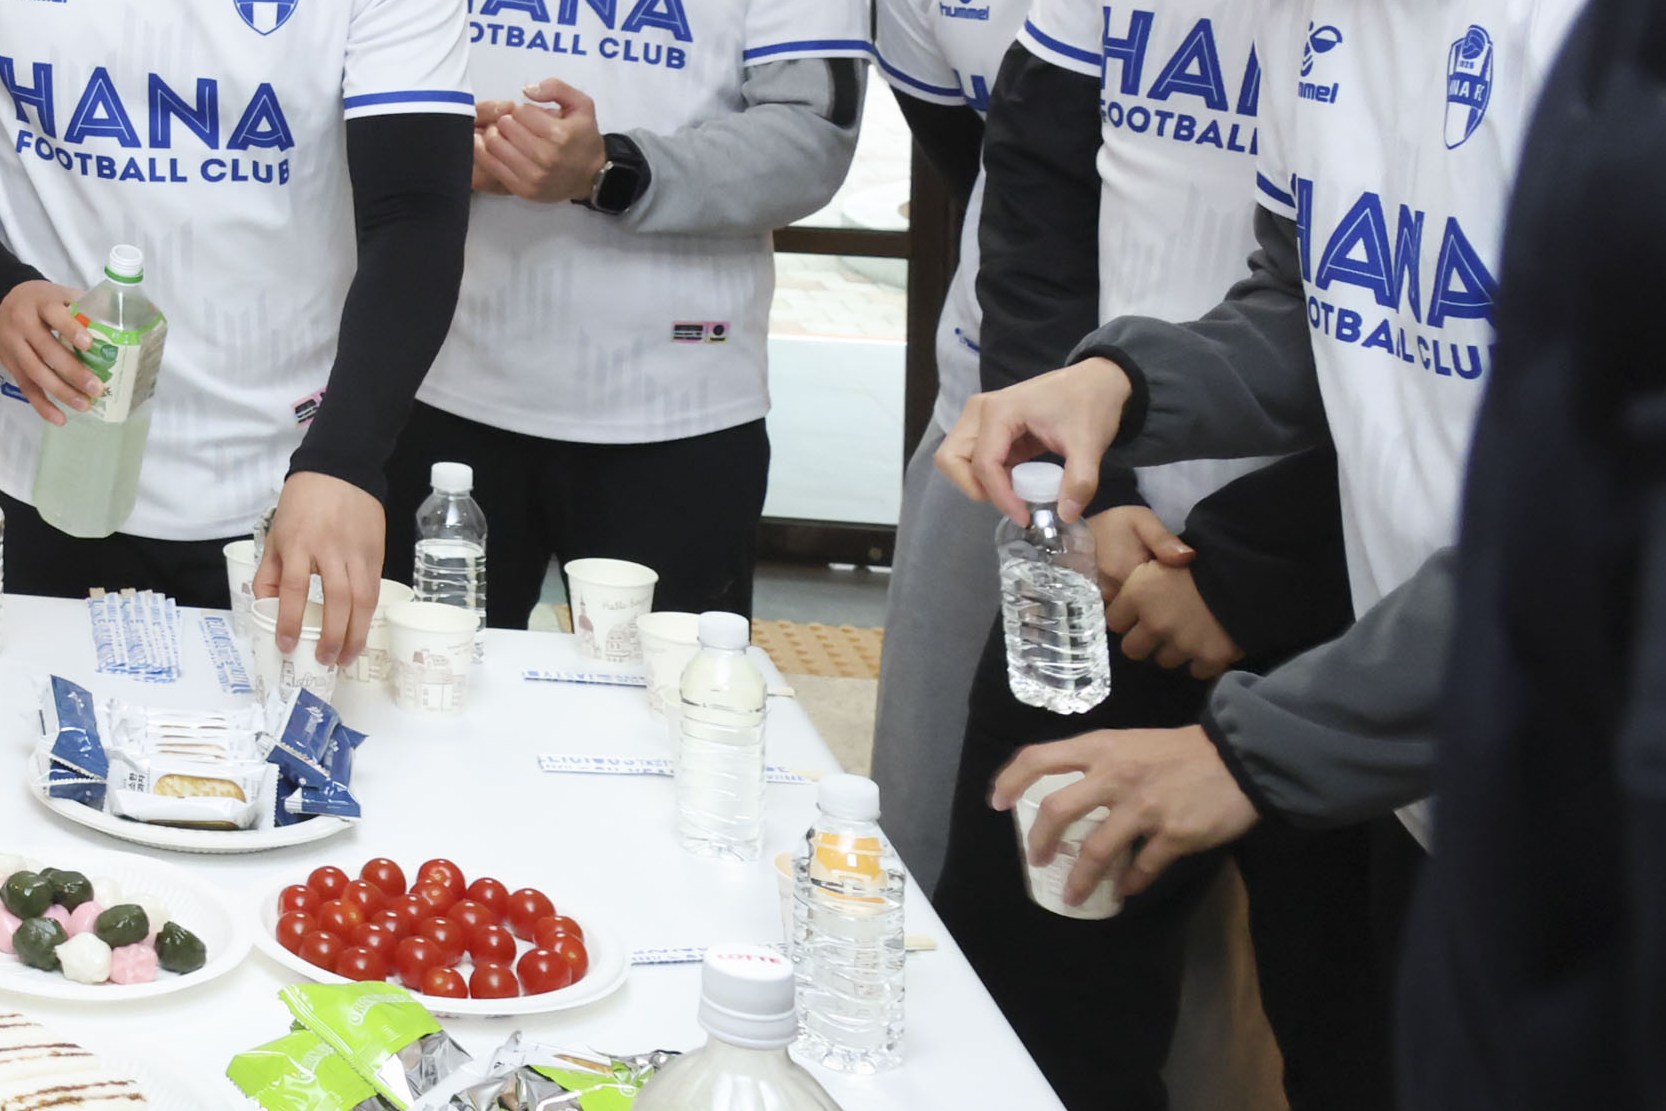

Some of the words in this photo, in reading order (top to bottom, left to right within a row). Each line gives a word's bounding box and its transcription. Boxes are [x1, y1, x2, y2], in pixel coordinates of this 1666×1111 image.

[939, 2, 990, 21] hummel
[598, 37, 687, 70] CLUB
[16, 129, 188, 182] FOOTBALL
[200, 158, 291, 186] CLUB
